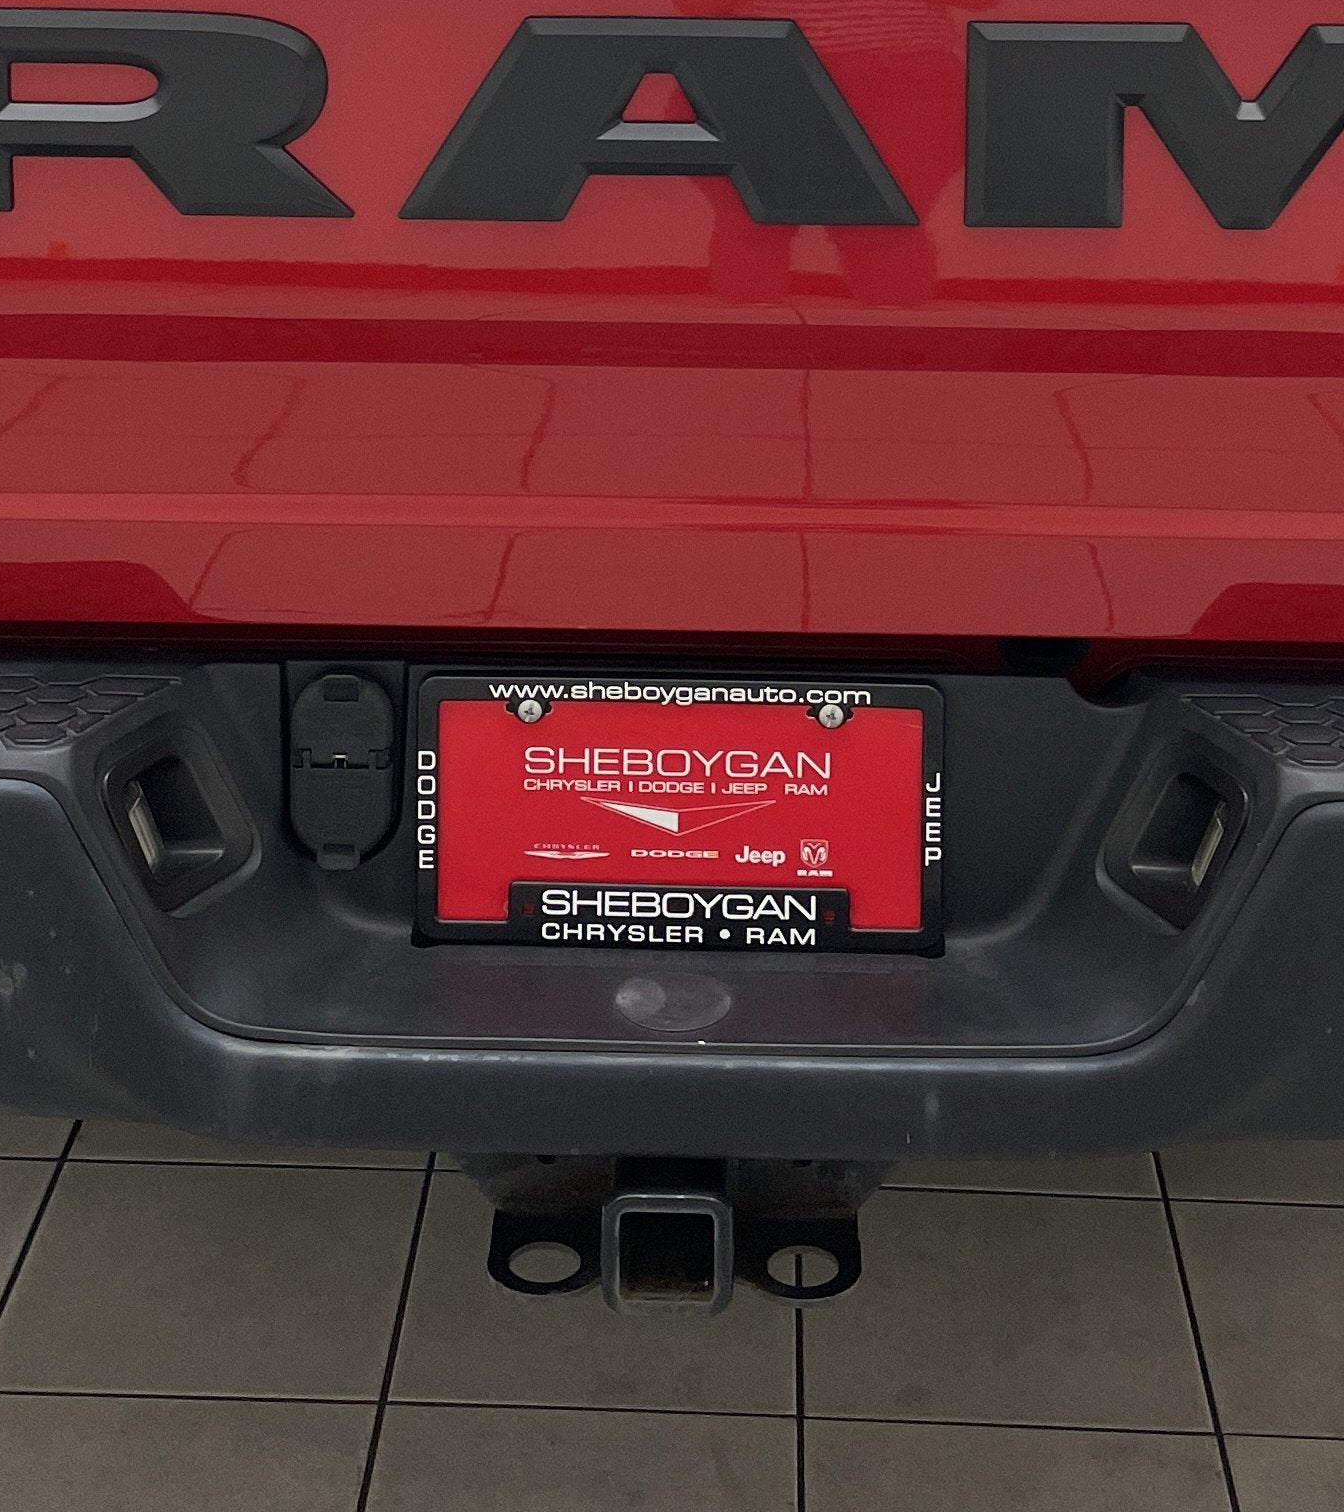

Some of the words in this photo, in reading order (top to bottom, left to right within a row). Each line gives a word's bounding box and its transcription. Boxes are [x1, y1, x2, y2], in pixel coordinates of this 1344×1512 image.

[488, 680, 872, 706] www.sheboyganauto.com
[523, 746, 831, 780] SHEBOYGAN
[523, 778, 621, 793] CHRYSLER
[638, 781, 705, 794] DODGE
[721, 782, 768, 795] JEEP
[784, 783, 828, 796] RAM
[417, 750, 436, 870] DODGE
[924, 772, 942, 867] JEEP
[630, 849, 720, 859] DODGE
[734, 845, 786, 867] Jeep
[541, 889, 817, 921] SHEBOYGAN
[541, 922, 704, 944] CHRYSLER
[746, 926, 817, 946] RAM
